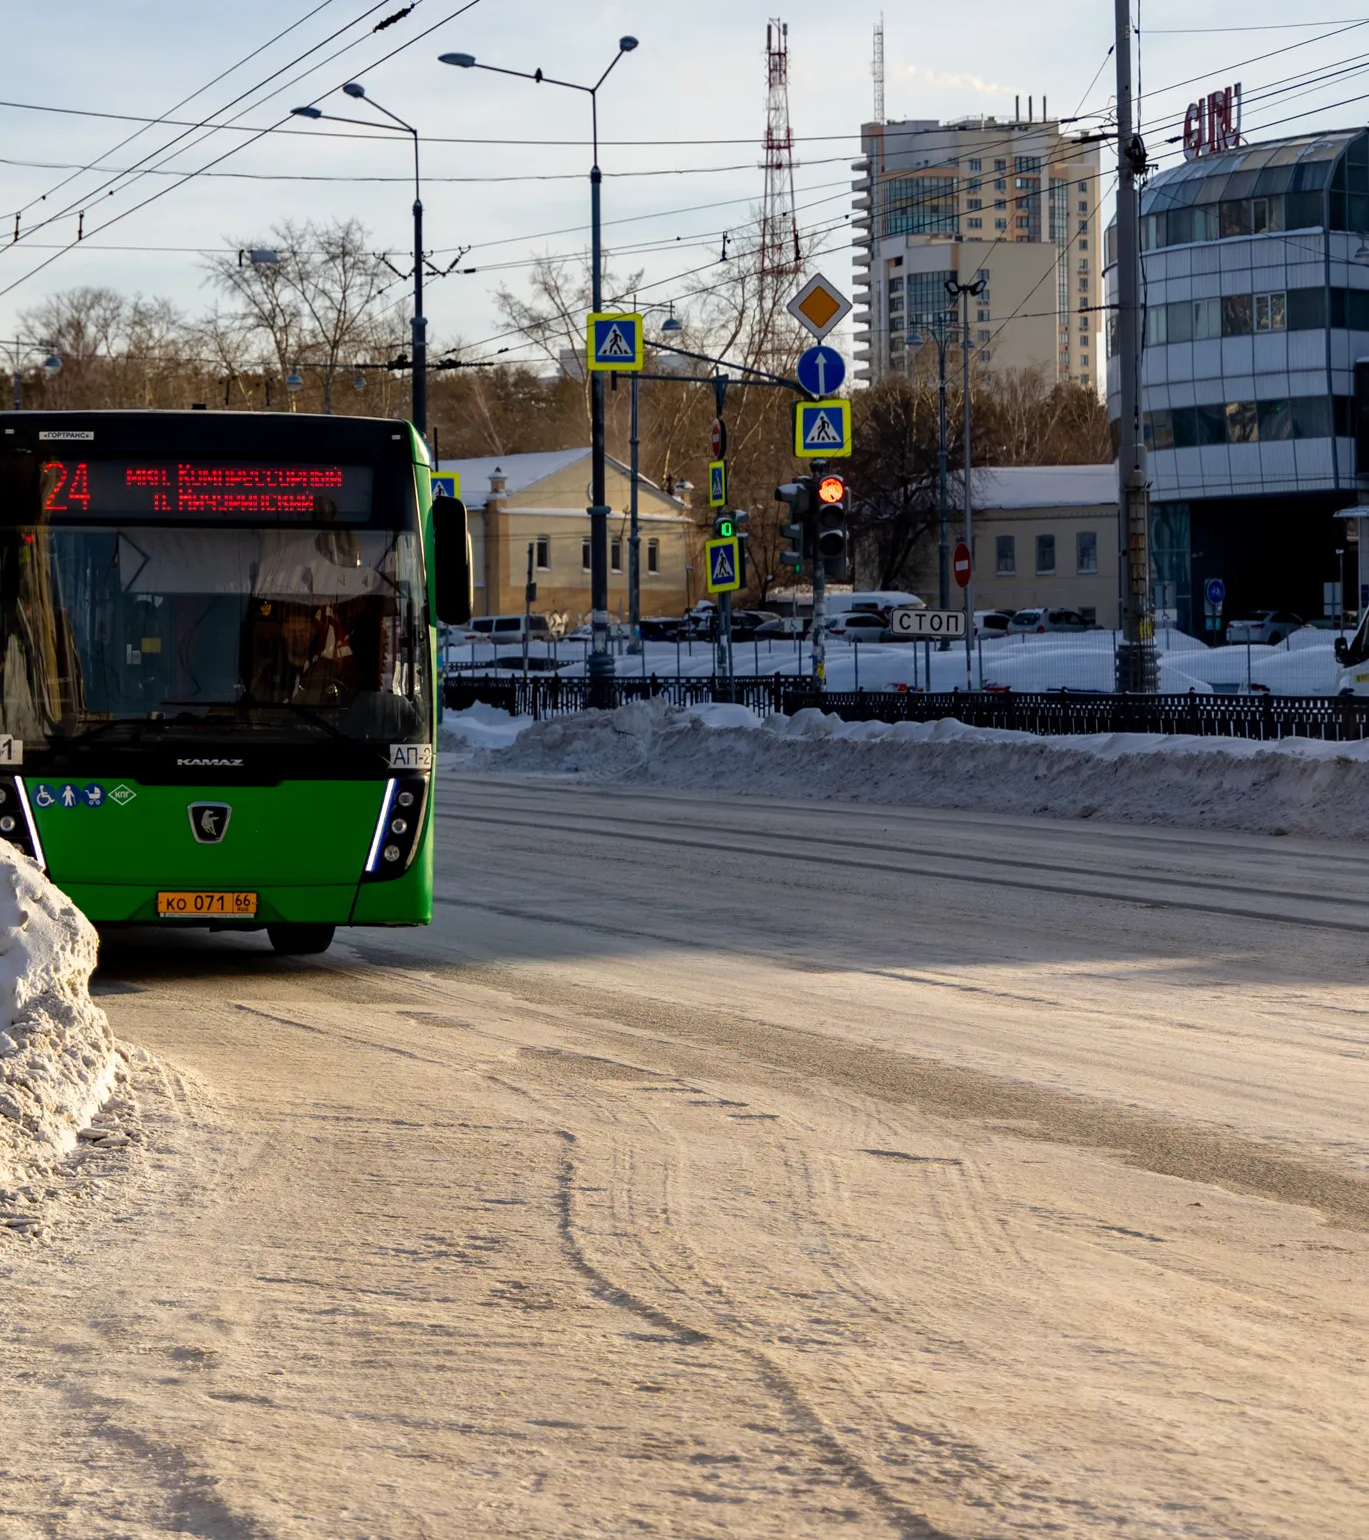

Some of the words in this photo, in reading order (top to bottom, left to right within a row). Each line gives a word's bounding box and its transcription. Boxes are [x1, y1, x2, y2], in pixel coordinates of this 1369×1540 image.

[1183, 82, 1241, 160] GURU
[44, 463, 90, 511] 24
[898, 612, 959, 632] СТОП
[177, 758, 244, 766] KAMAZ
[194, 894, 225, 911] 071
[234, 894, 251, 906] 66
